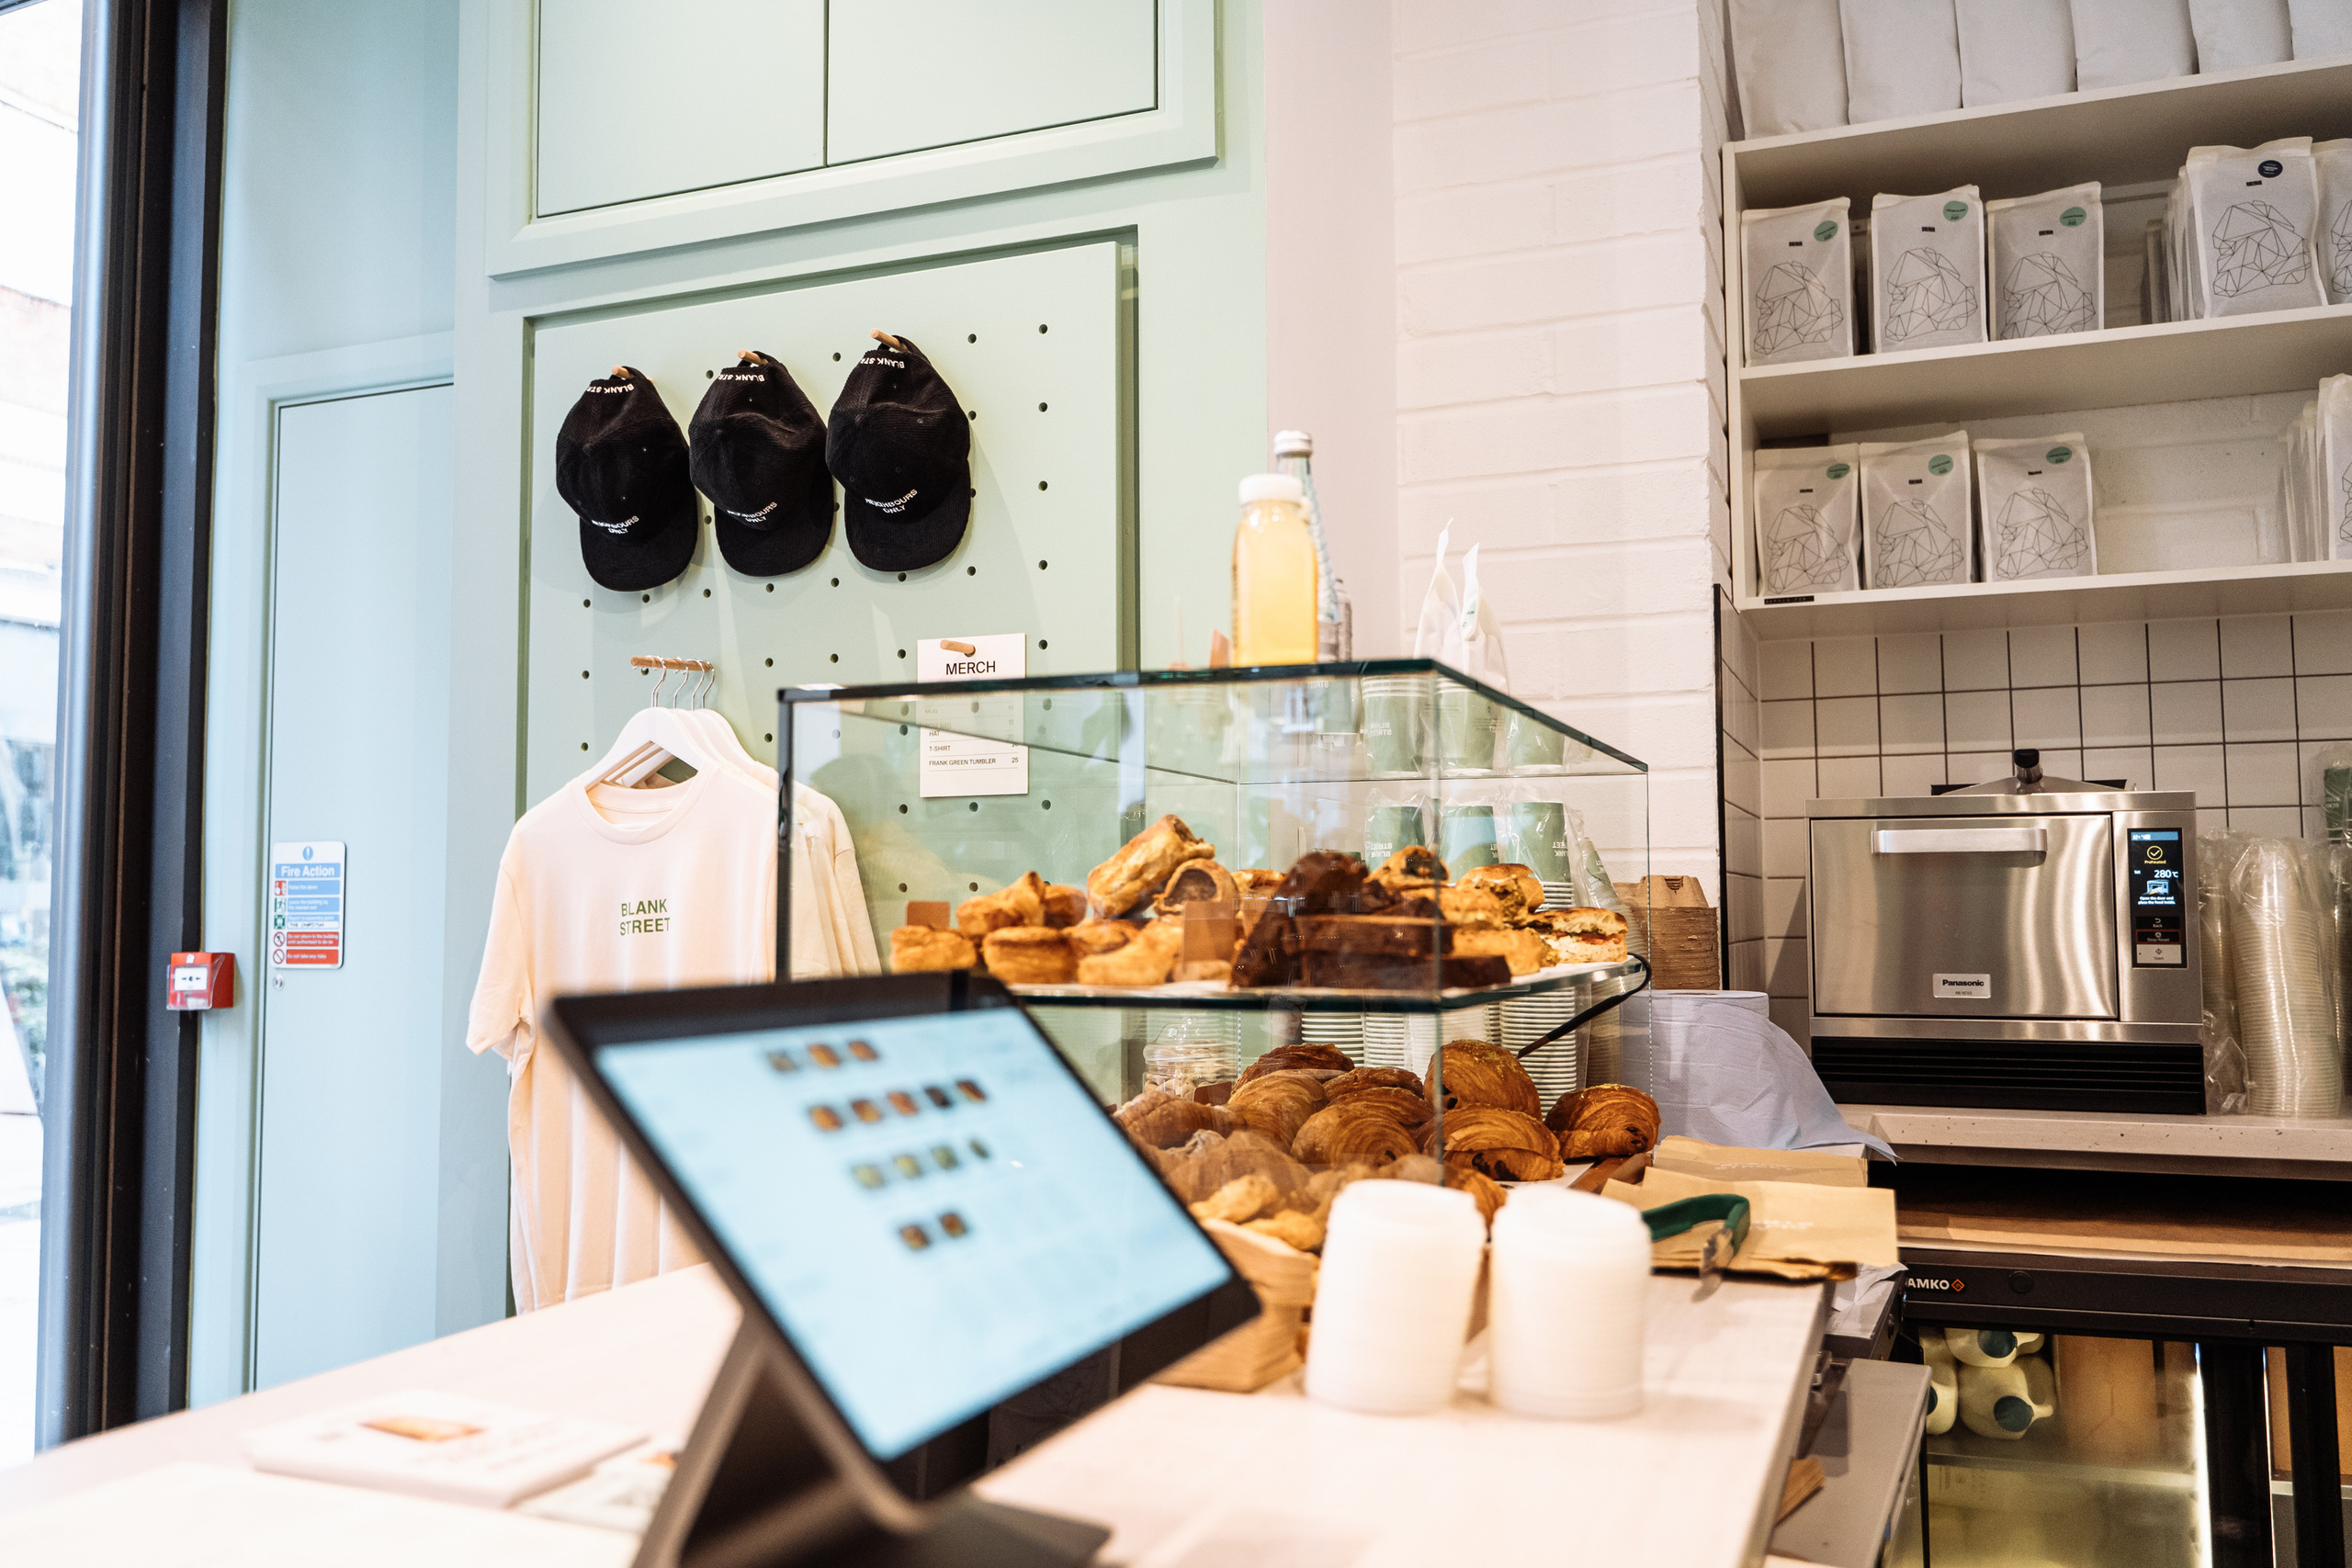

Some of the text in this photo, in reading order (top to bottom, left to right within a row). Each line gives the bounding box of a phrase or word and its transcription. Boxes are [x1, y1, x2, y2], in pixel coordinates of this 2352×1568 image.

[876, 357, 905, 369] BLANK
[735, 374, 765, 382] BLANK
[604, 383, 635, 394] BLANK
[945, 660, 996, 675] MERCH
[281, 865, 335, 877] Fire Action
[621, 898, 668, 917] BLANK
[620, 918, 671, 936] STREET
[1905, 1278, 1950, 1291] AMKO
